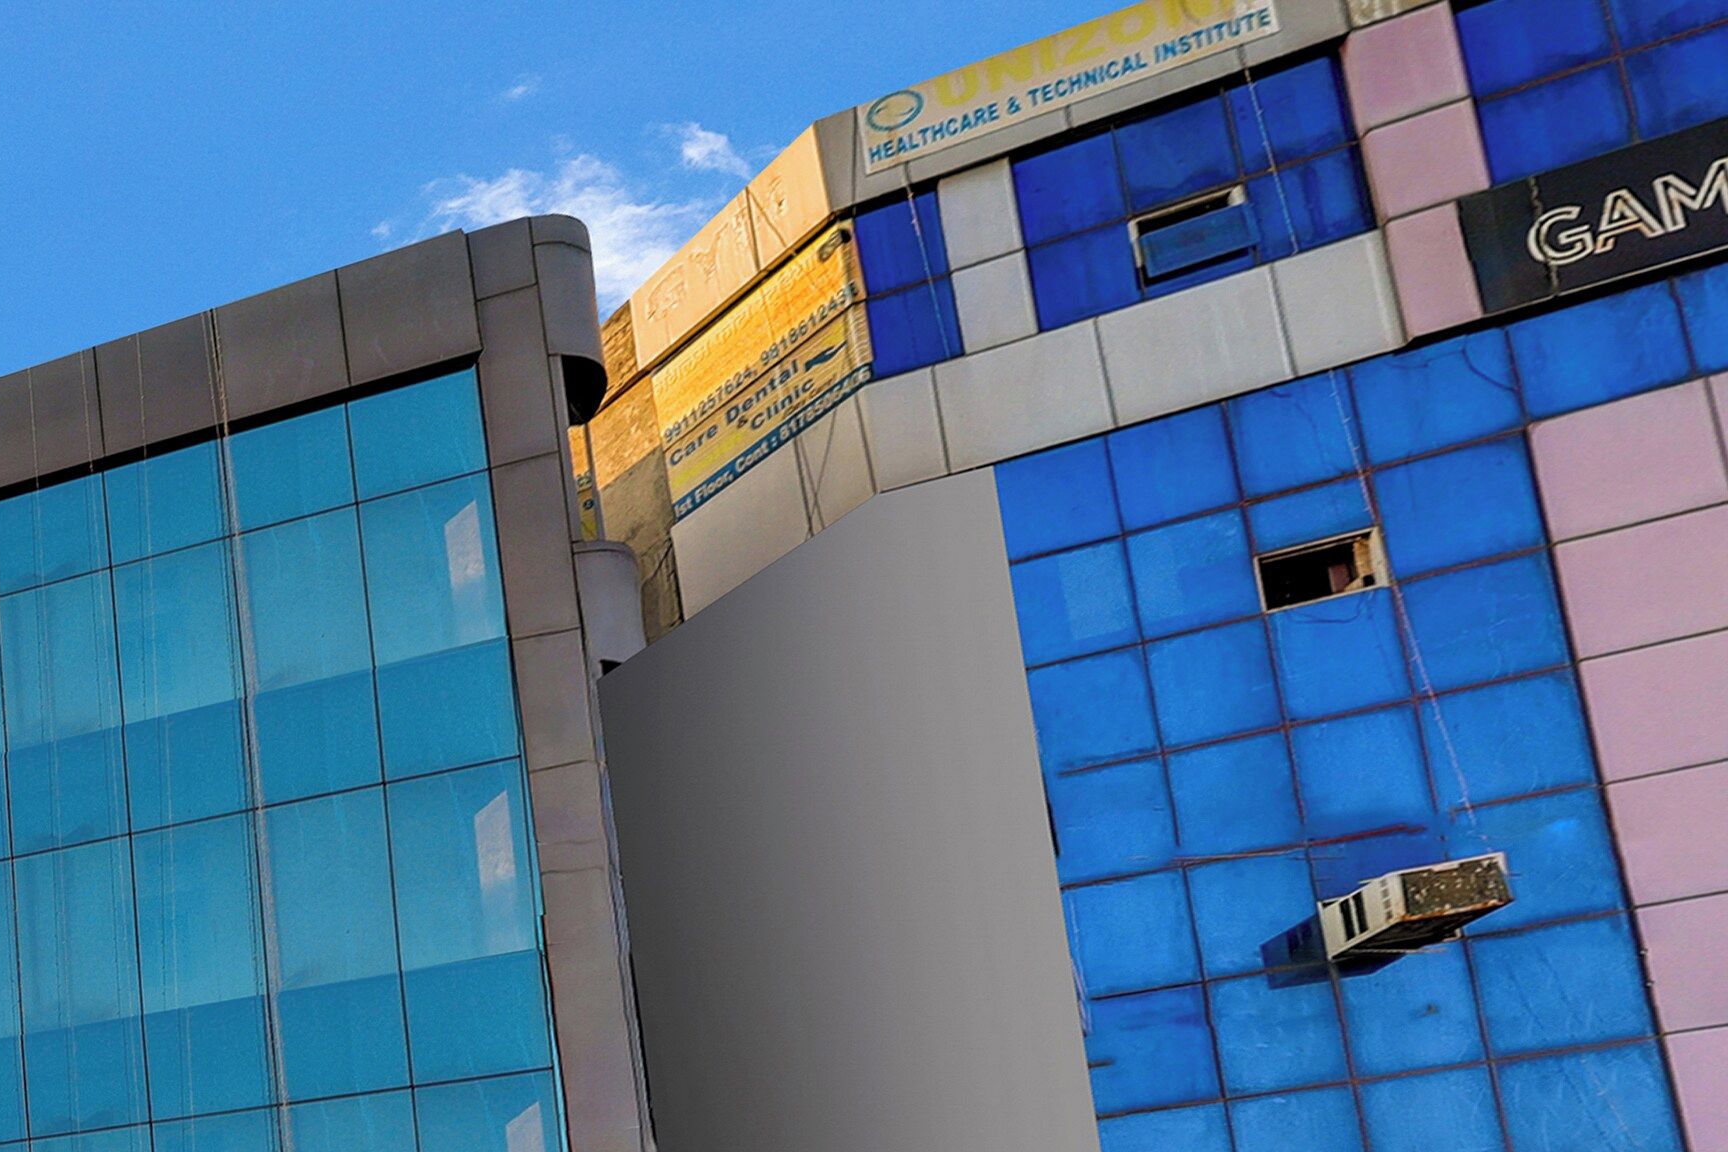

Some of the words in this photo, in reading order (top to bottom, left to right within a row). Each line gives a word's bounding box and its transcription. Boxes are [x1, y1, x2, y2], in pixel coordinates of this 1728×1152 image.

[868, 102, 1000, 163] HEALTHCARE
[1007, 94, 1022, 115] &
[1027, 51, 1148, 107] TECHNICAL
[1154, 7, 1271, 64] INSTITUTE
[671, 423, 719, 465] Care
[726, 360, 799, 425] Dental
[750, 378, 815, 431] Clinic
